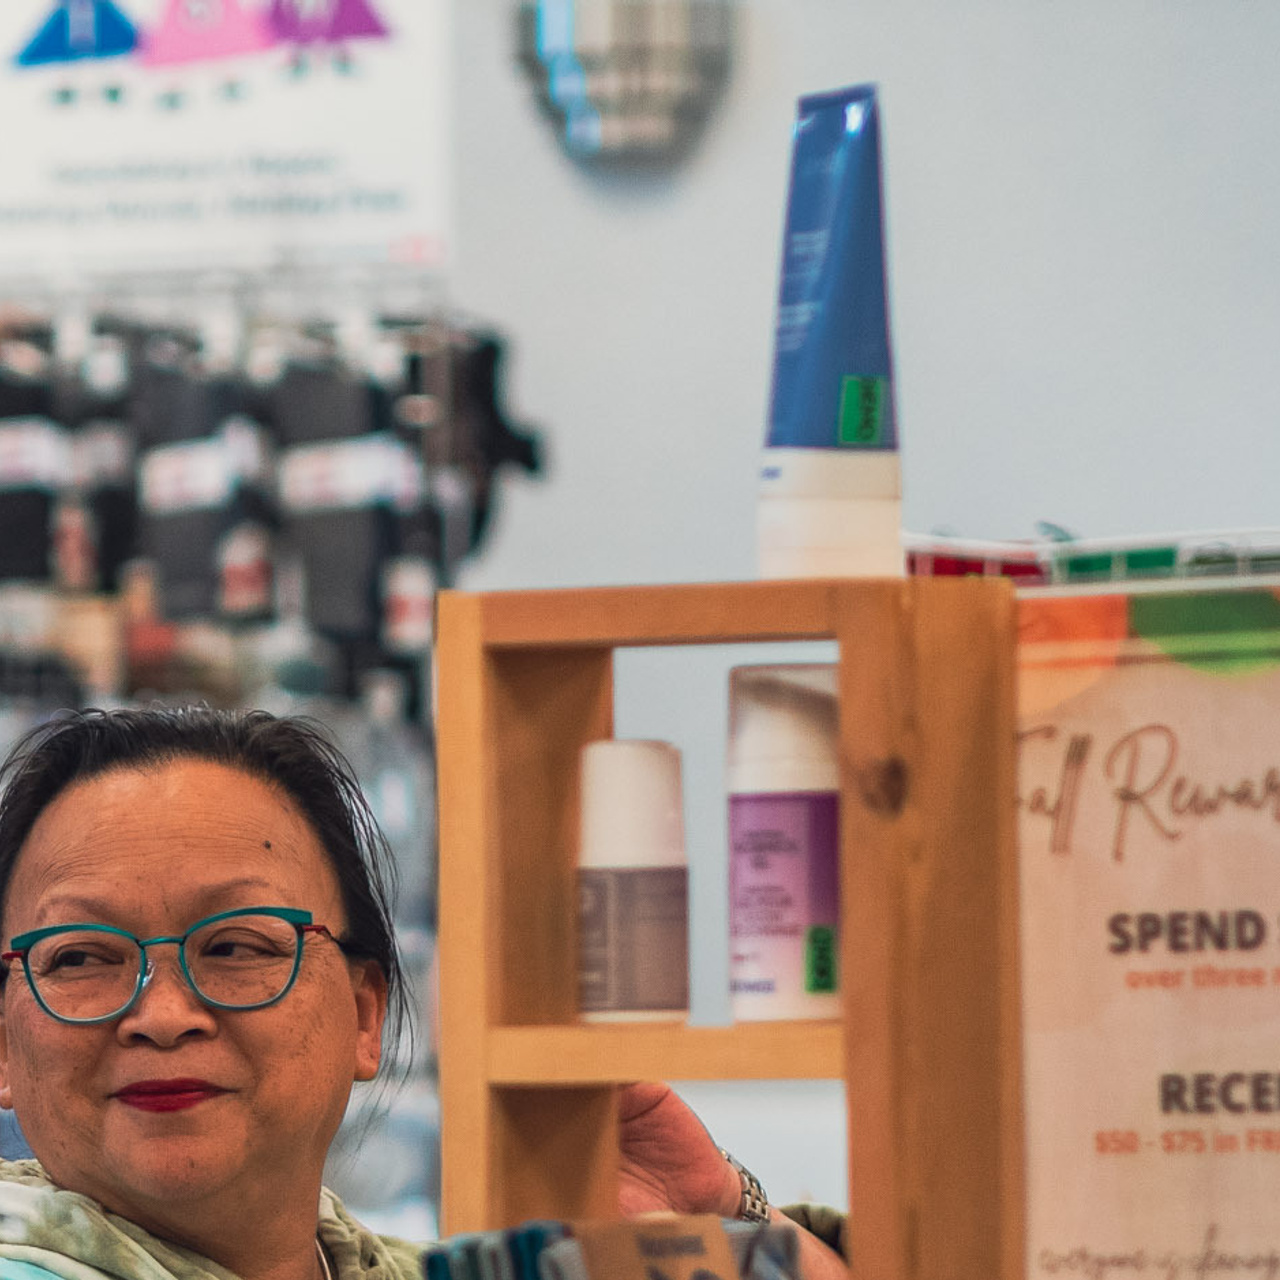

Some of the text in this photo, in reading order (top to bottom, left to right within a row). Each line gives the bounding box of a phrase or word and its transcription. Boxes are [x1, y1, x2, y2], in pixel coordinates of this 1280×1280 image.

[1107, 909, 1267, 953] SPEND
[1125, 965, 1267, 989] over three
[1158, 1072, 1280, 1115] RECE
